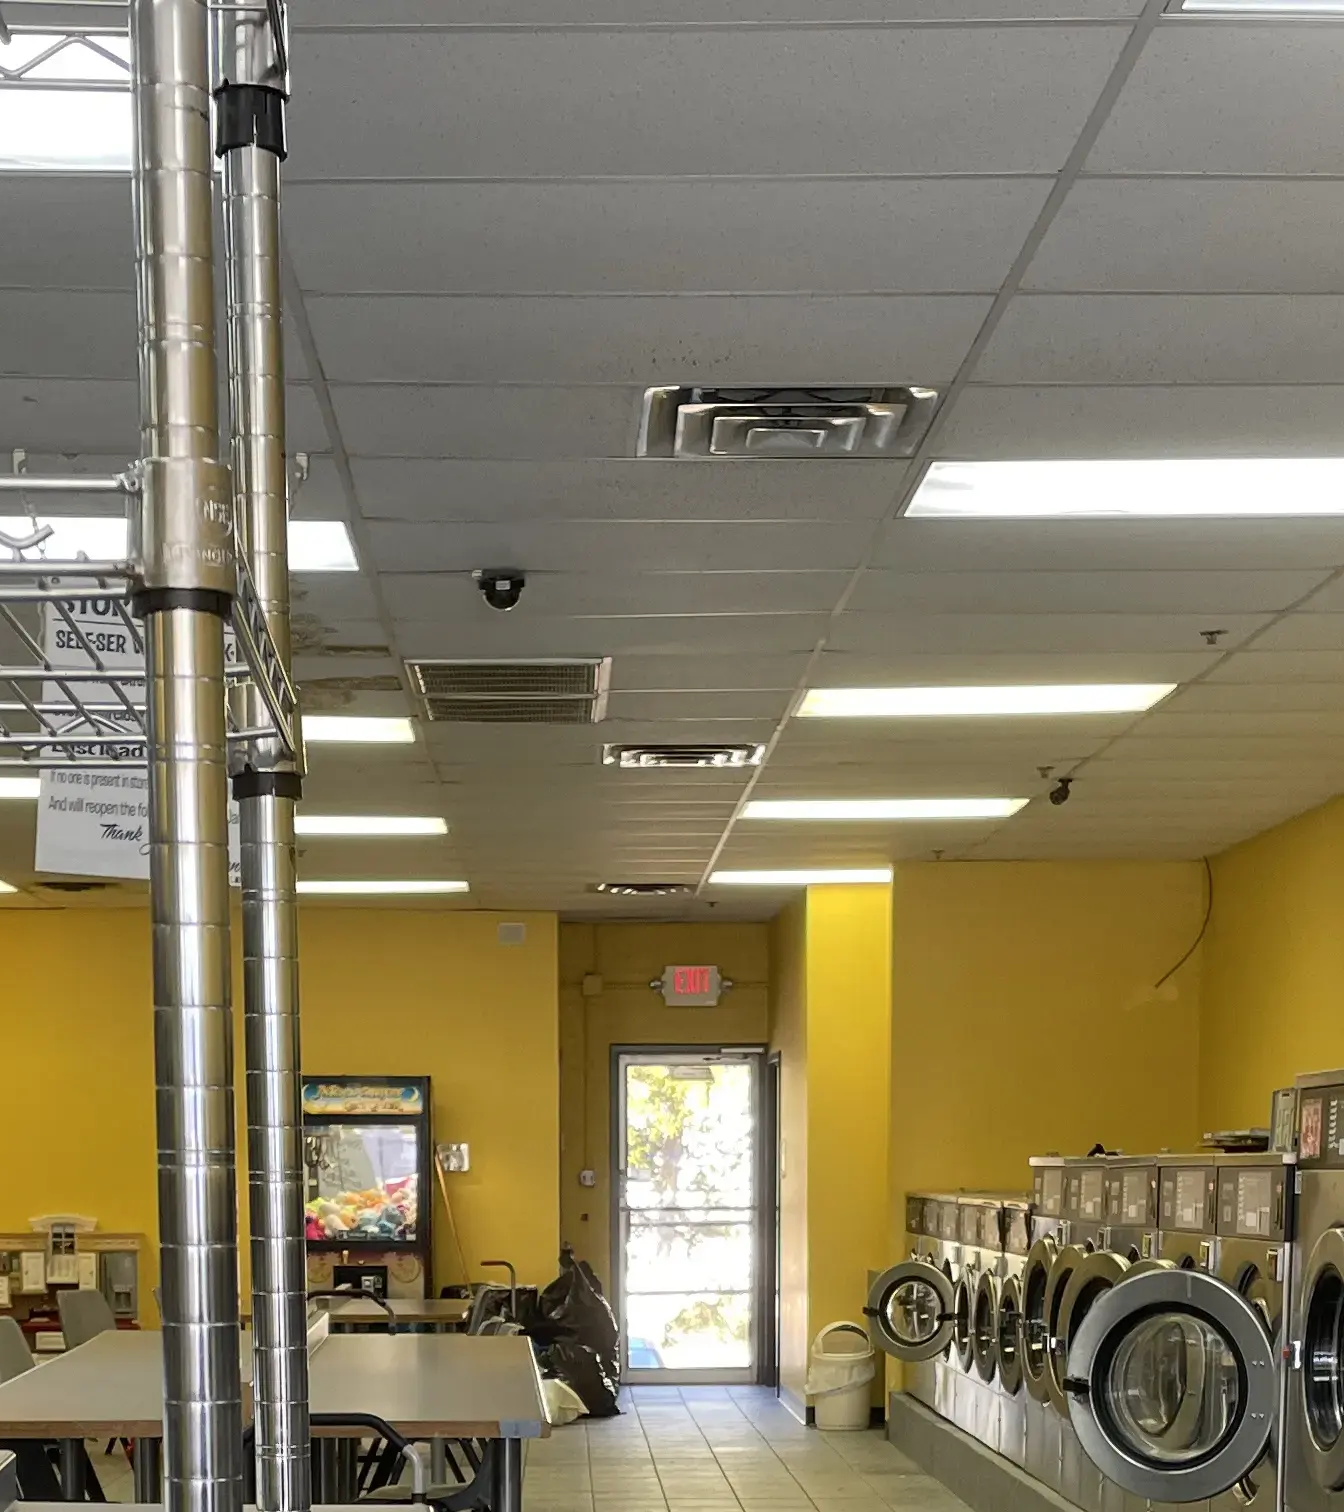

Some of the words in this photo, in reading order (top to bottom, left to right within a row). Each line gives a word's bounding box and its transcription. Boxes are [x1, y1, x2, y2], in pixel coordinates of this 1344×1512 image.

[48, 796, 67, 812] And
[69, 797, 84, 812] will
[85, 801, 118, 818] reopen
[120, 802, 135, 817] the
[99, 824, 143, 841] Thank
[674, 967, 709, 994] EXIT
